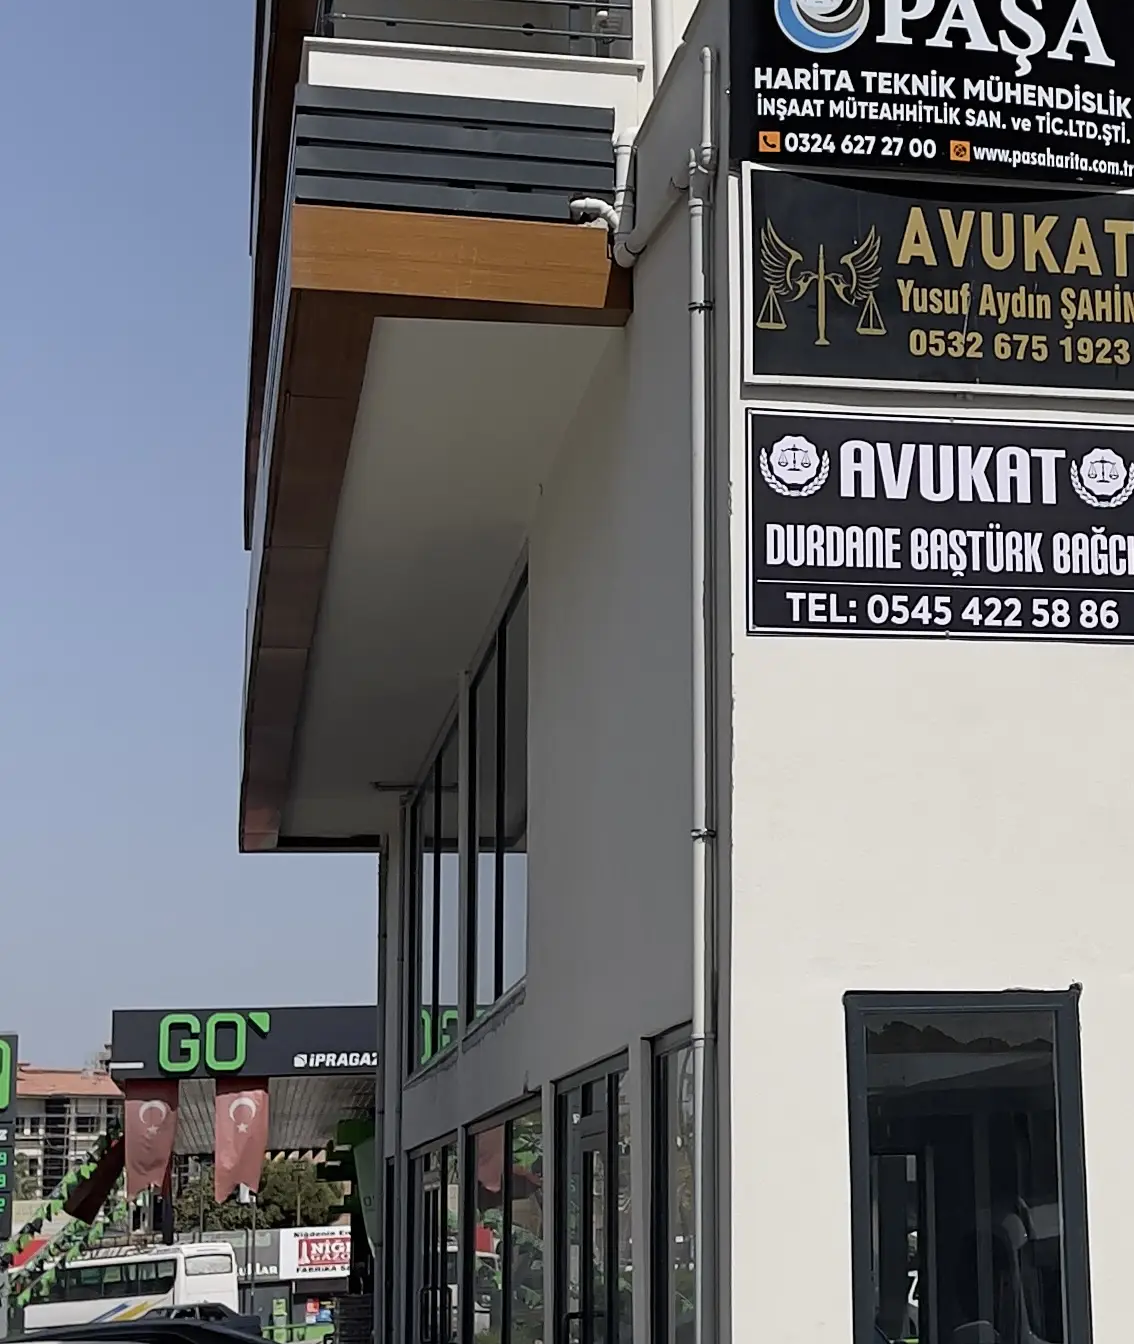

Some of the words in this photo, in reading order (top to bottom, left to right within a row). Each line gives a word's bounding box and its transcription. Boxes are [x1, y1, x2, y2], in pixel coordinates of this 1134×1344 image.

[754, 62, 855, 92] HARİTA
[860, 69, 956, 99] TEKNİK
[963, 75, 1132, 119] MÜHENDİSLİK
[757, 93, 824, 121] İNŞAAT
[829, 96, 961, 125] MÜTEAHHİTLİK
[965, 108, 1007, 130] SAN.
[1011, 116, 1031, 131] ve
[784, 132, 836, 153] 0324
[840, 135, 876, 155] 627
[881, 136, 903, 156] 27
[908, 138, 937, 159] 00
[973, 146, 1134, 177] www.pasaharita.com.tr
[896, 279, 971, 315] Yusuf
[979, 283, 1051, 324] Aydın
[909, 328, 983, 358] 0532
[994, 333, 1048, 361] 675
[1059, 336, 1130, 365] 1923
[840, 440, 1066, 504] AVUKAT
[766, 524, 901, 568] DURDANE
[910, 523, 1043, 577] BAŞTÜRK
[1053, 526, 1134, 576] BAĞCI
[786, 592, 857, 623] TEL:
[867, 594, 952, 625] 0545
[961, 597, 1022, 627] 422
[1032, 598, 1070, 628] 58
[1079, 599, 1119, 629] 86
